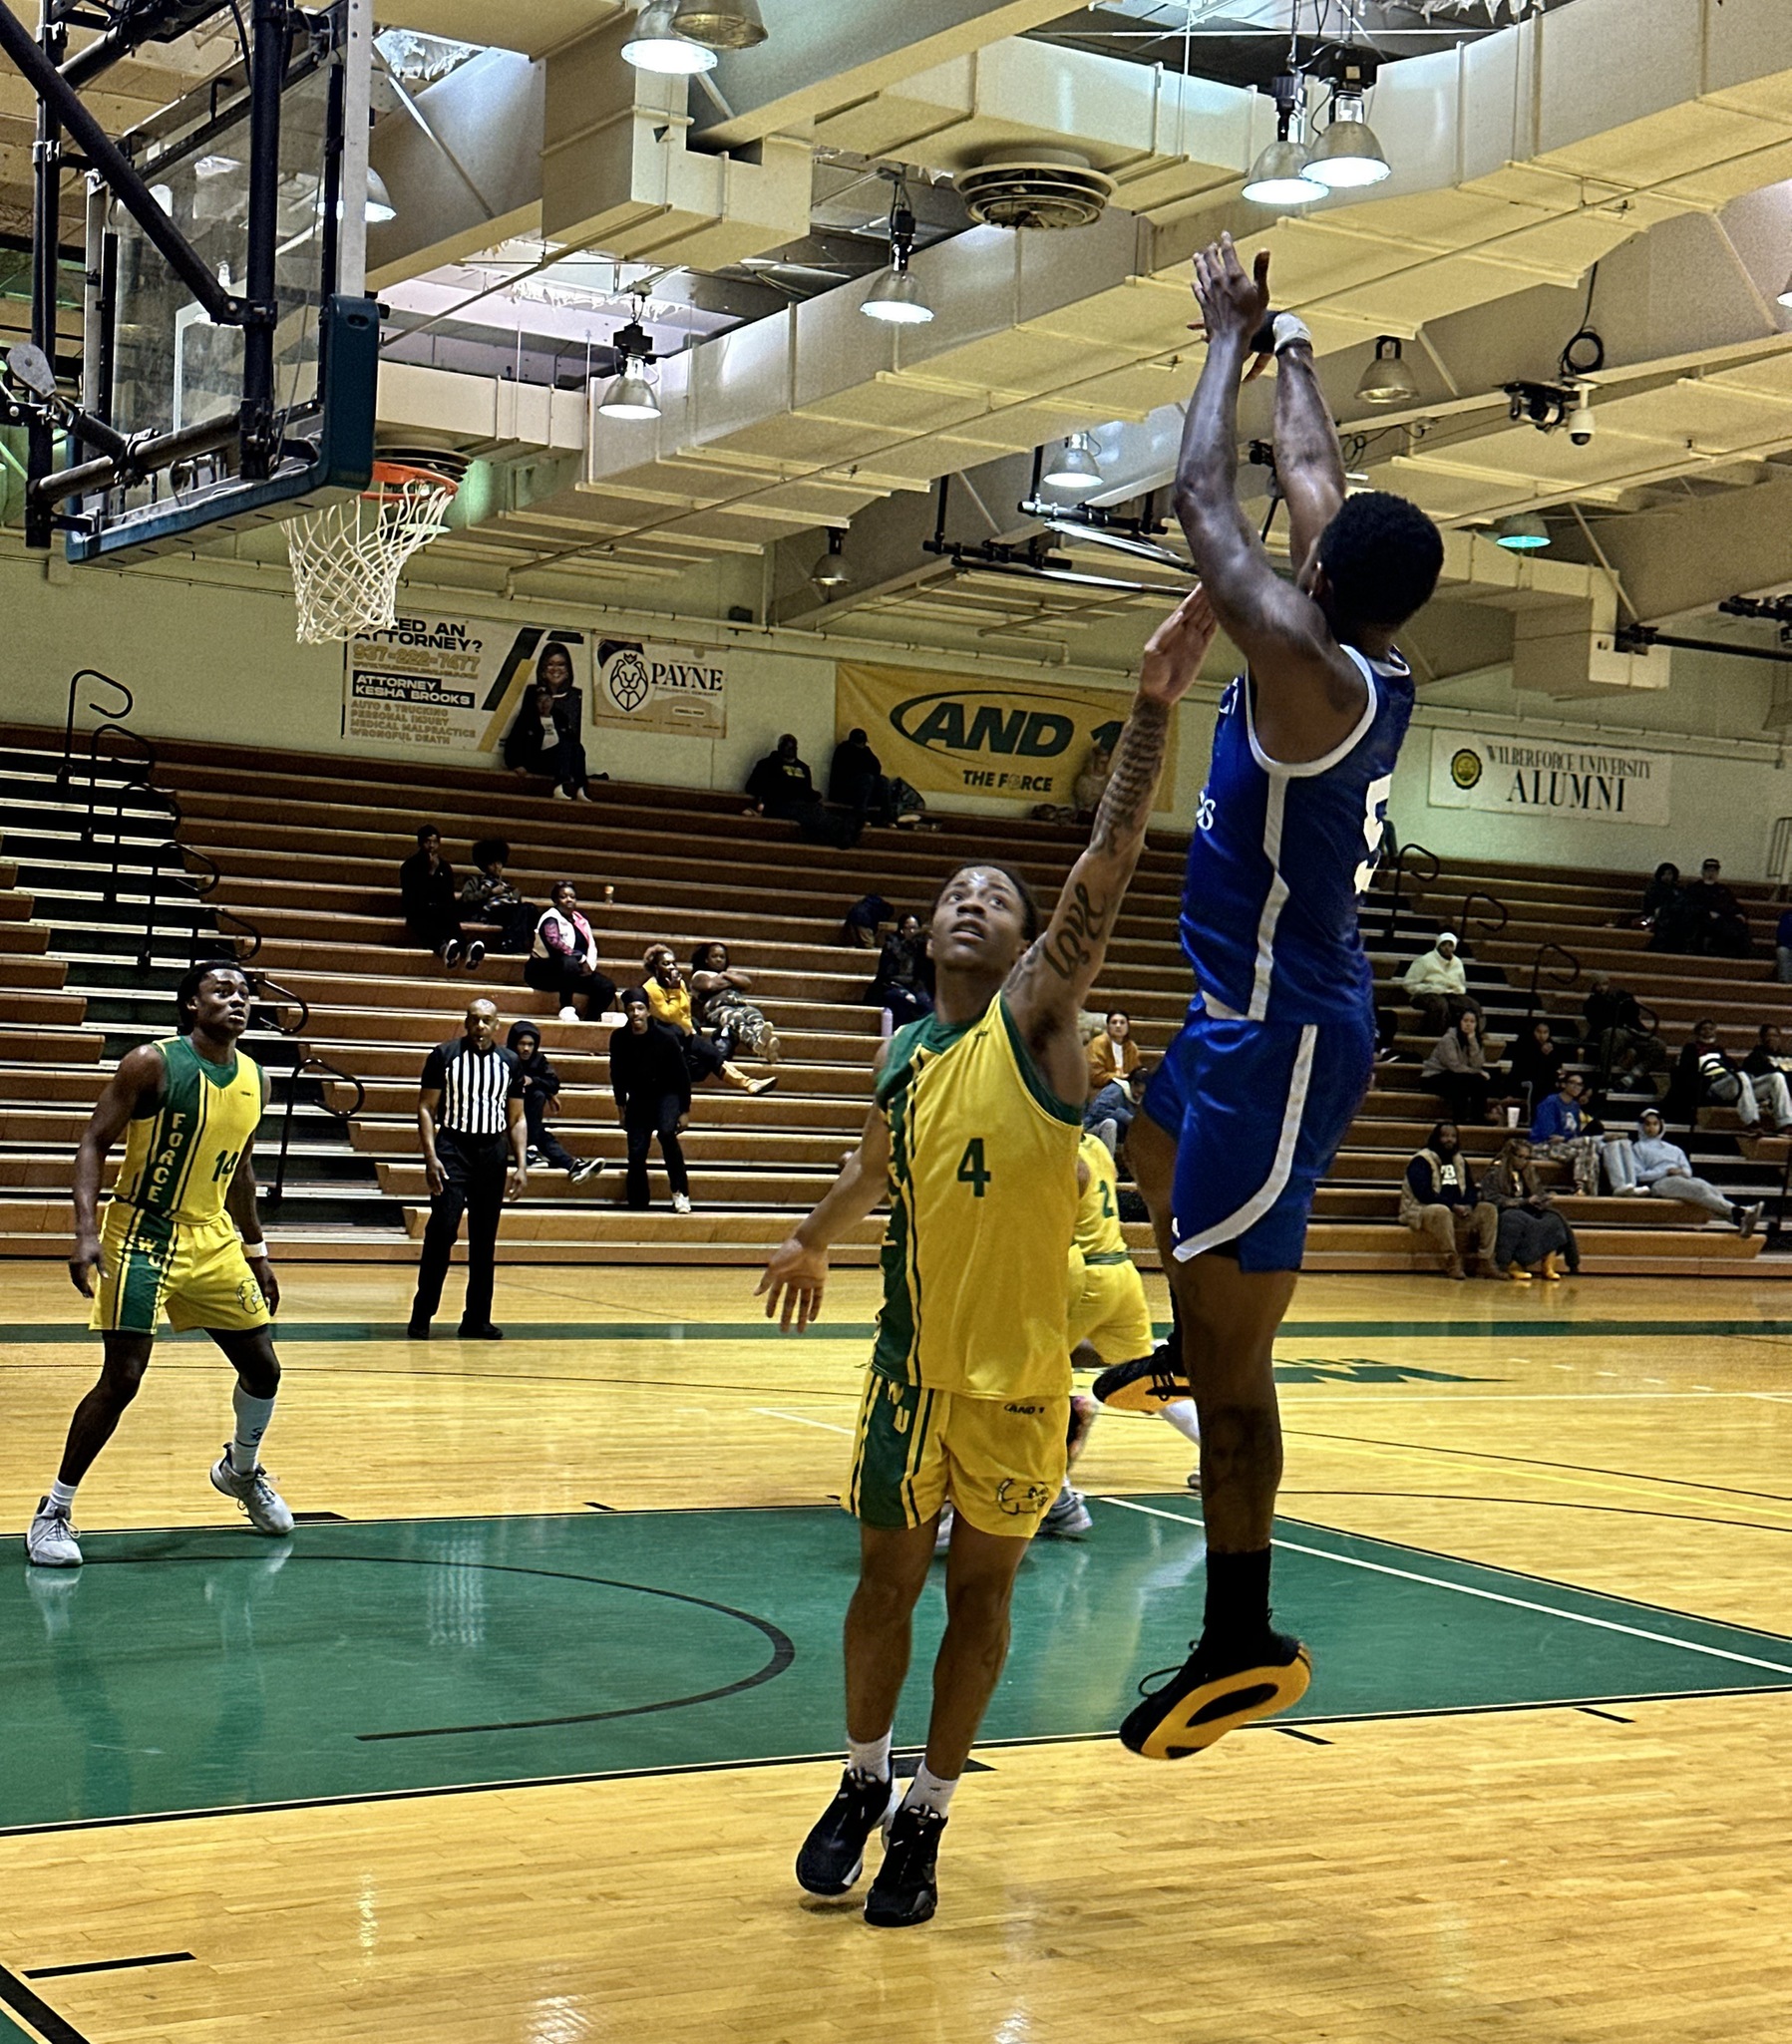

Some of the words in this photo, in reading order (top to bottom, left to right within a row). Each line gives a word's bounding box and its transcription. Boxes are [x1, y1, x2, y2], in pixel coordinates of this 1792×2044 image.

[434, 622, 466, 638] AN
[353, 630, 484, 653] ATTORNEY?
[356, 674, 437, 692] ATTORNEY
[650, 662, 724, 691] PAYNE
[355, 684, 406, 699] KESHA
[410, 690, 471, 705] BROOKS
[350, 709, 408, 723] PERSONAL
[411, 715, 449, 727] INJURY
[351, 700, 381, 711] AUTO
[394, 704, 449, 717] TRUCKING
[350, 718, 400, 731] MEDICAL
[402, 723, 477, 739] MALPRACTICE
[350, 727, 412, 742] WRONGFUL
[415, 734, 451, 745] DEATH
[910, 701, 1075, 758] AND
[1486, 745, 1575, 771] WILBERFORCE
[1579, 756, 1654, 779] UNIVERSITY
[962, 770, 995, 787] THE
[1506, 769, 1625, 813] ALUMNI
[147, 1113, 186, 1203] FORCE
[211, 1150, 239, 1183] 14
[956, 1138, 991, 1197] 4
